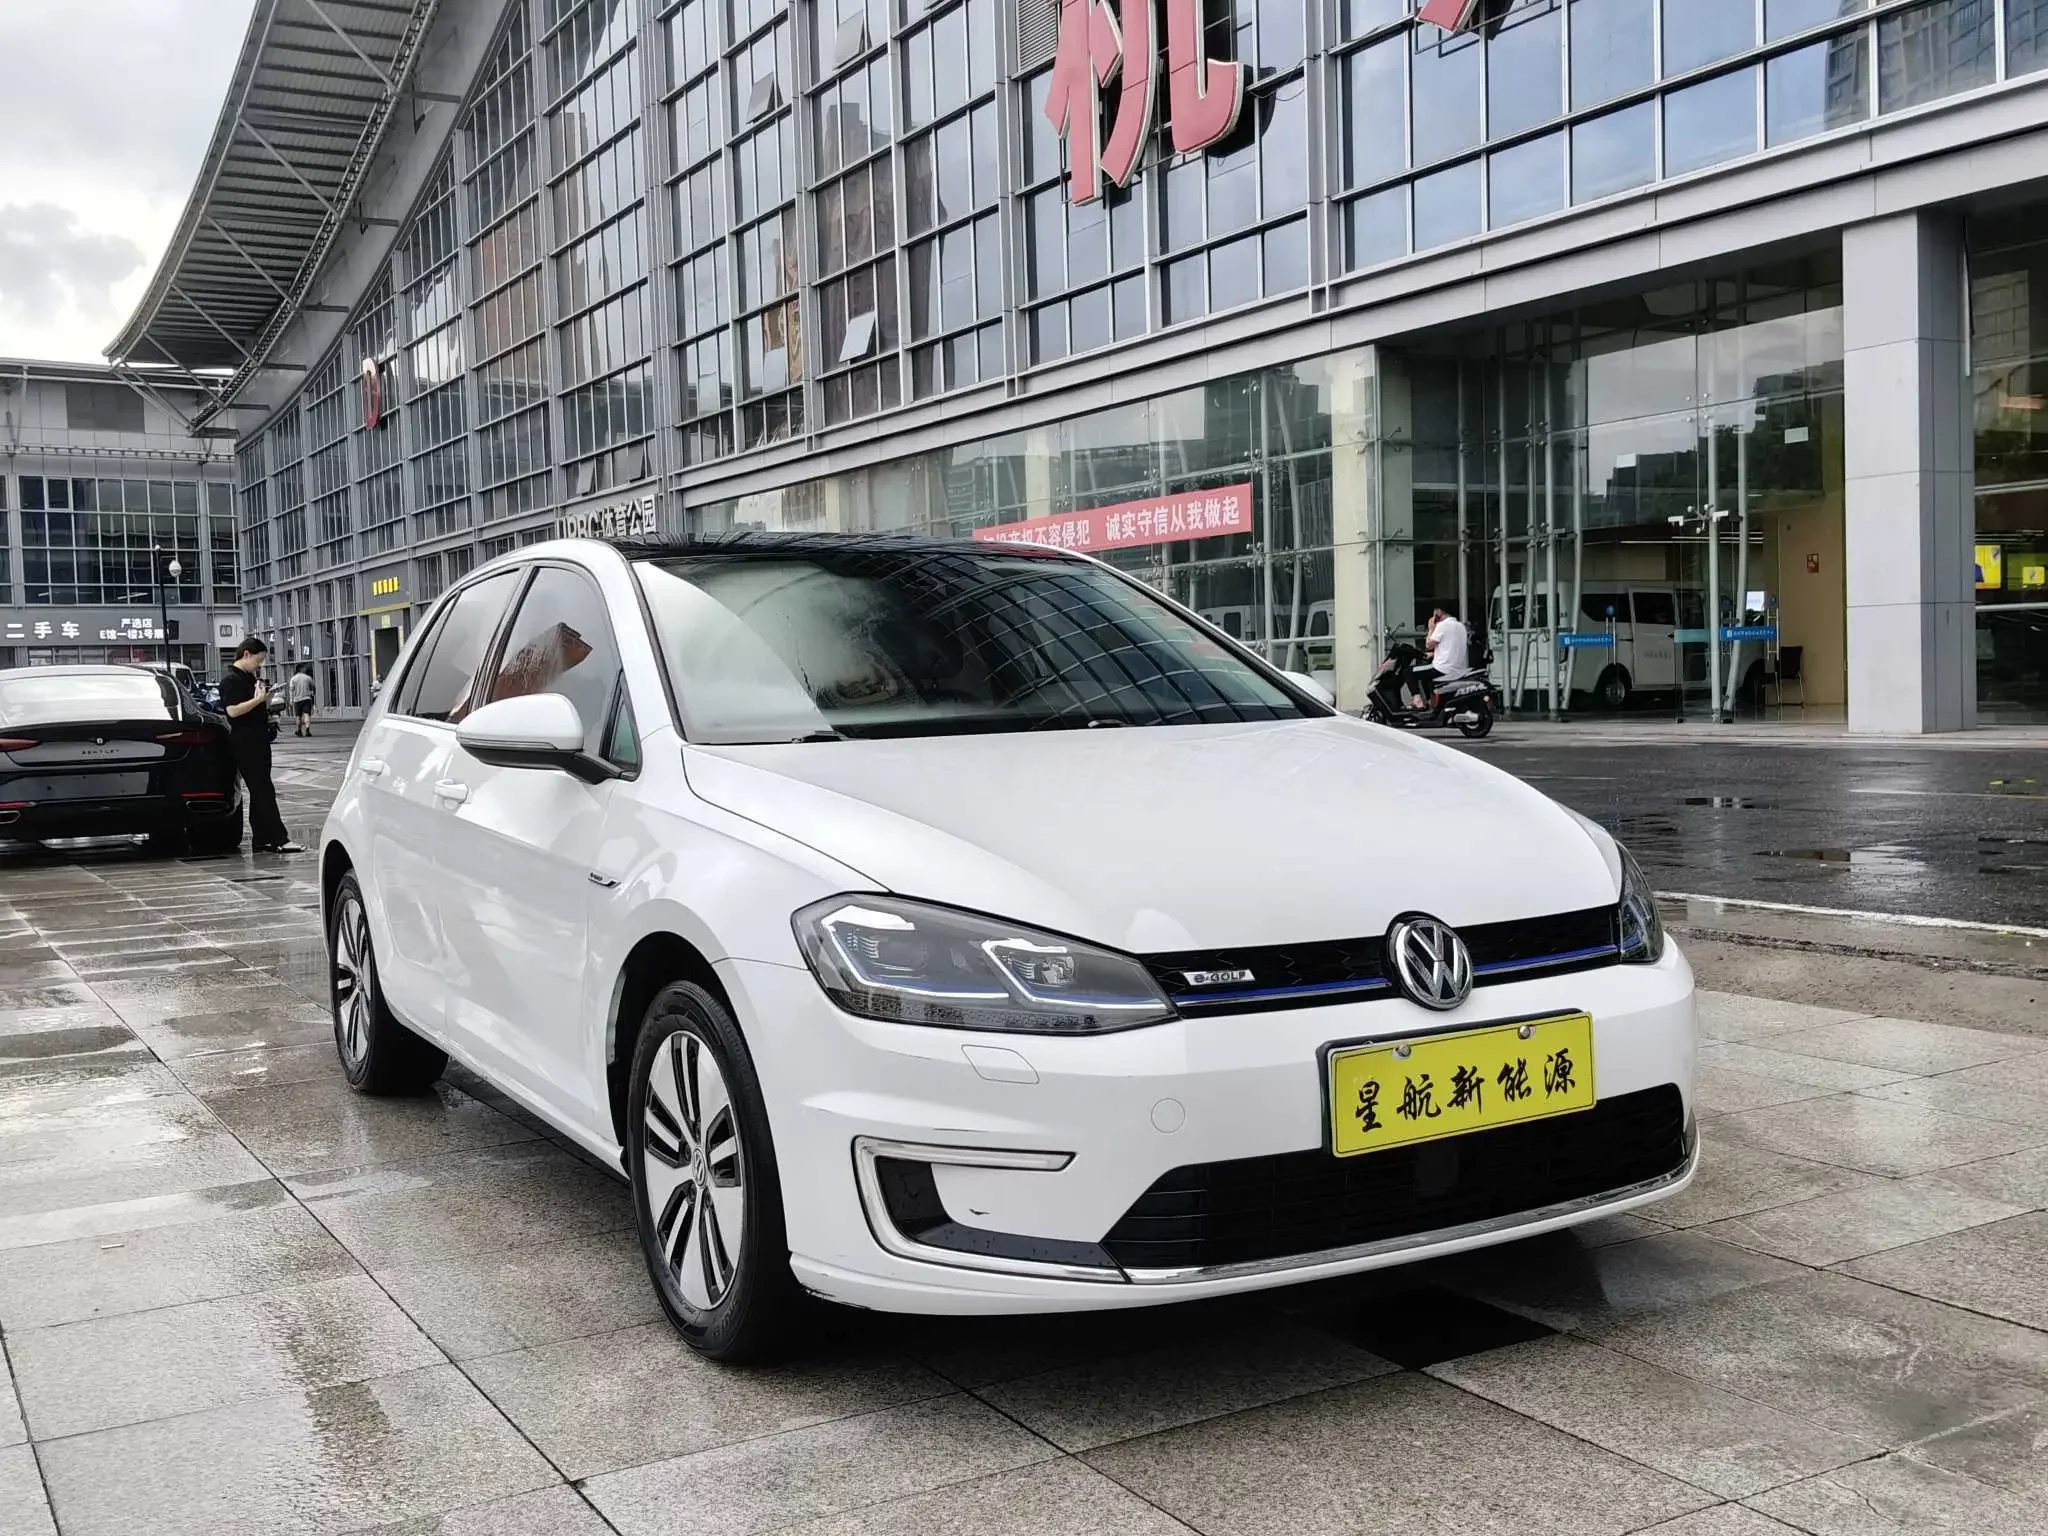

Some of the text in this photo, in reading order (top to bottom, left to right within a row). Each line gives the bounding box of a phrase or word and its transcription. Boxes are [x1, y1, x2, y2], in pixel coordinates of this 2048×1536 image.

[1105, 496, 1241, 542] 诚实守信从我做起
[6, 620, 81, 639] 二手车
[1355, 1047, 1576, 1133] 星航新能源
